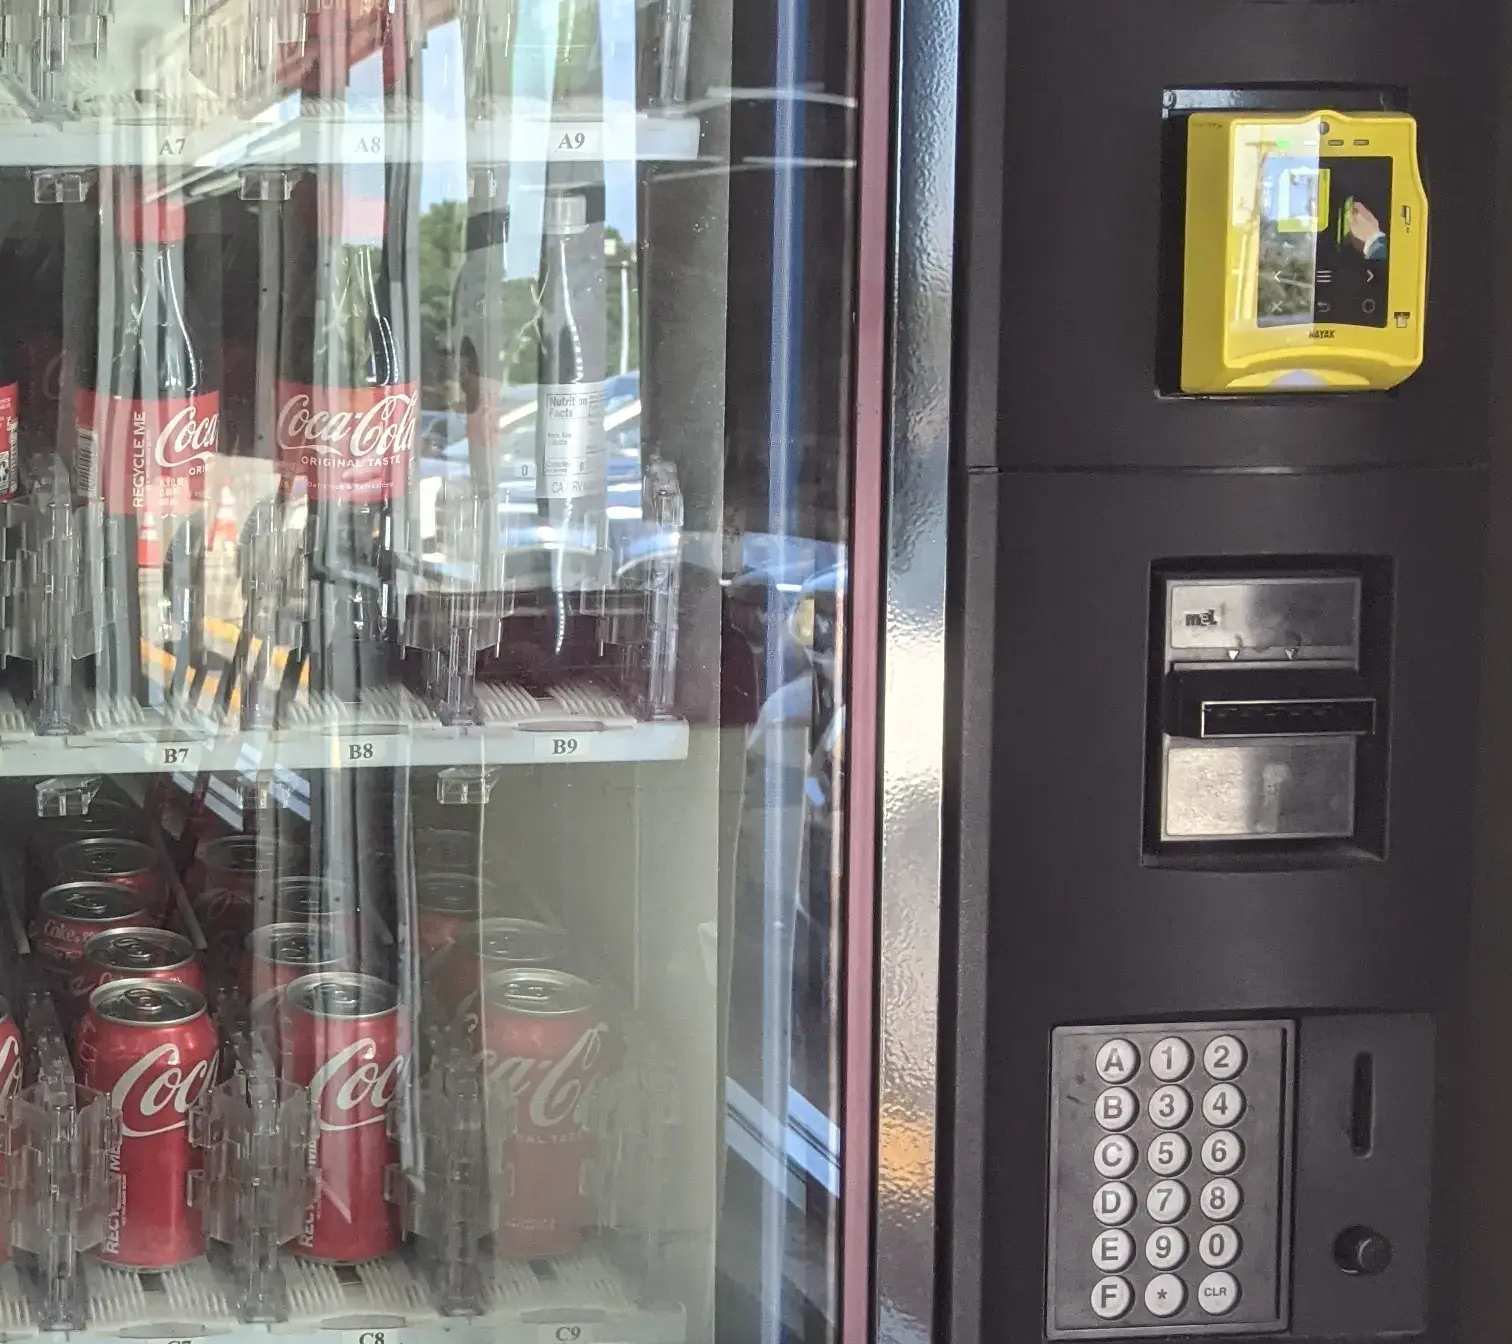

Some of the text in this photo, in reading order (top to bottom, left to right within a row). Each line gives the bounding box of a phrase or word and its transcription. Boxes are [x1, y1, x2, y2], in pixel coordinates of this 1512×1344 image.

[158, 137, 186, 156] A7
[355, 136, 381, 154] A8
[558, 131, 586, 150] A9
[132, 412, 146, 508] RECYCLE ME
[301, 456, 401, 468] ORIGINAL TASTE
[163, 747, 189, 764] B7
[348, 743, 374, 760] B8
[552, 738, 578, 755] B9
[1103, 1045, 1230, 1072] A 1 2
[1103, 1092, 1228, 1119] B 3 4
[1101, 1139, 1227, 1167] C 5 6
[1101, 1186, 1226, 1214] D 7 8
[1100, 1233, 1225, 1261] E 9 0
[1100, 1285, 1227, 1308] F CLR
[554, 1325, 581, 1342] C9
